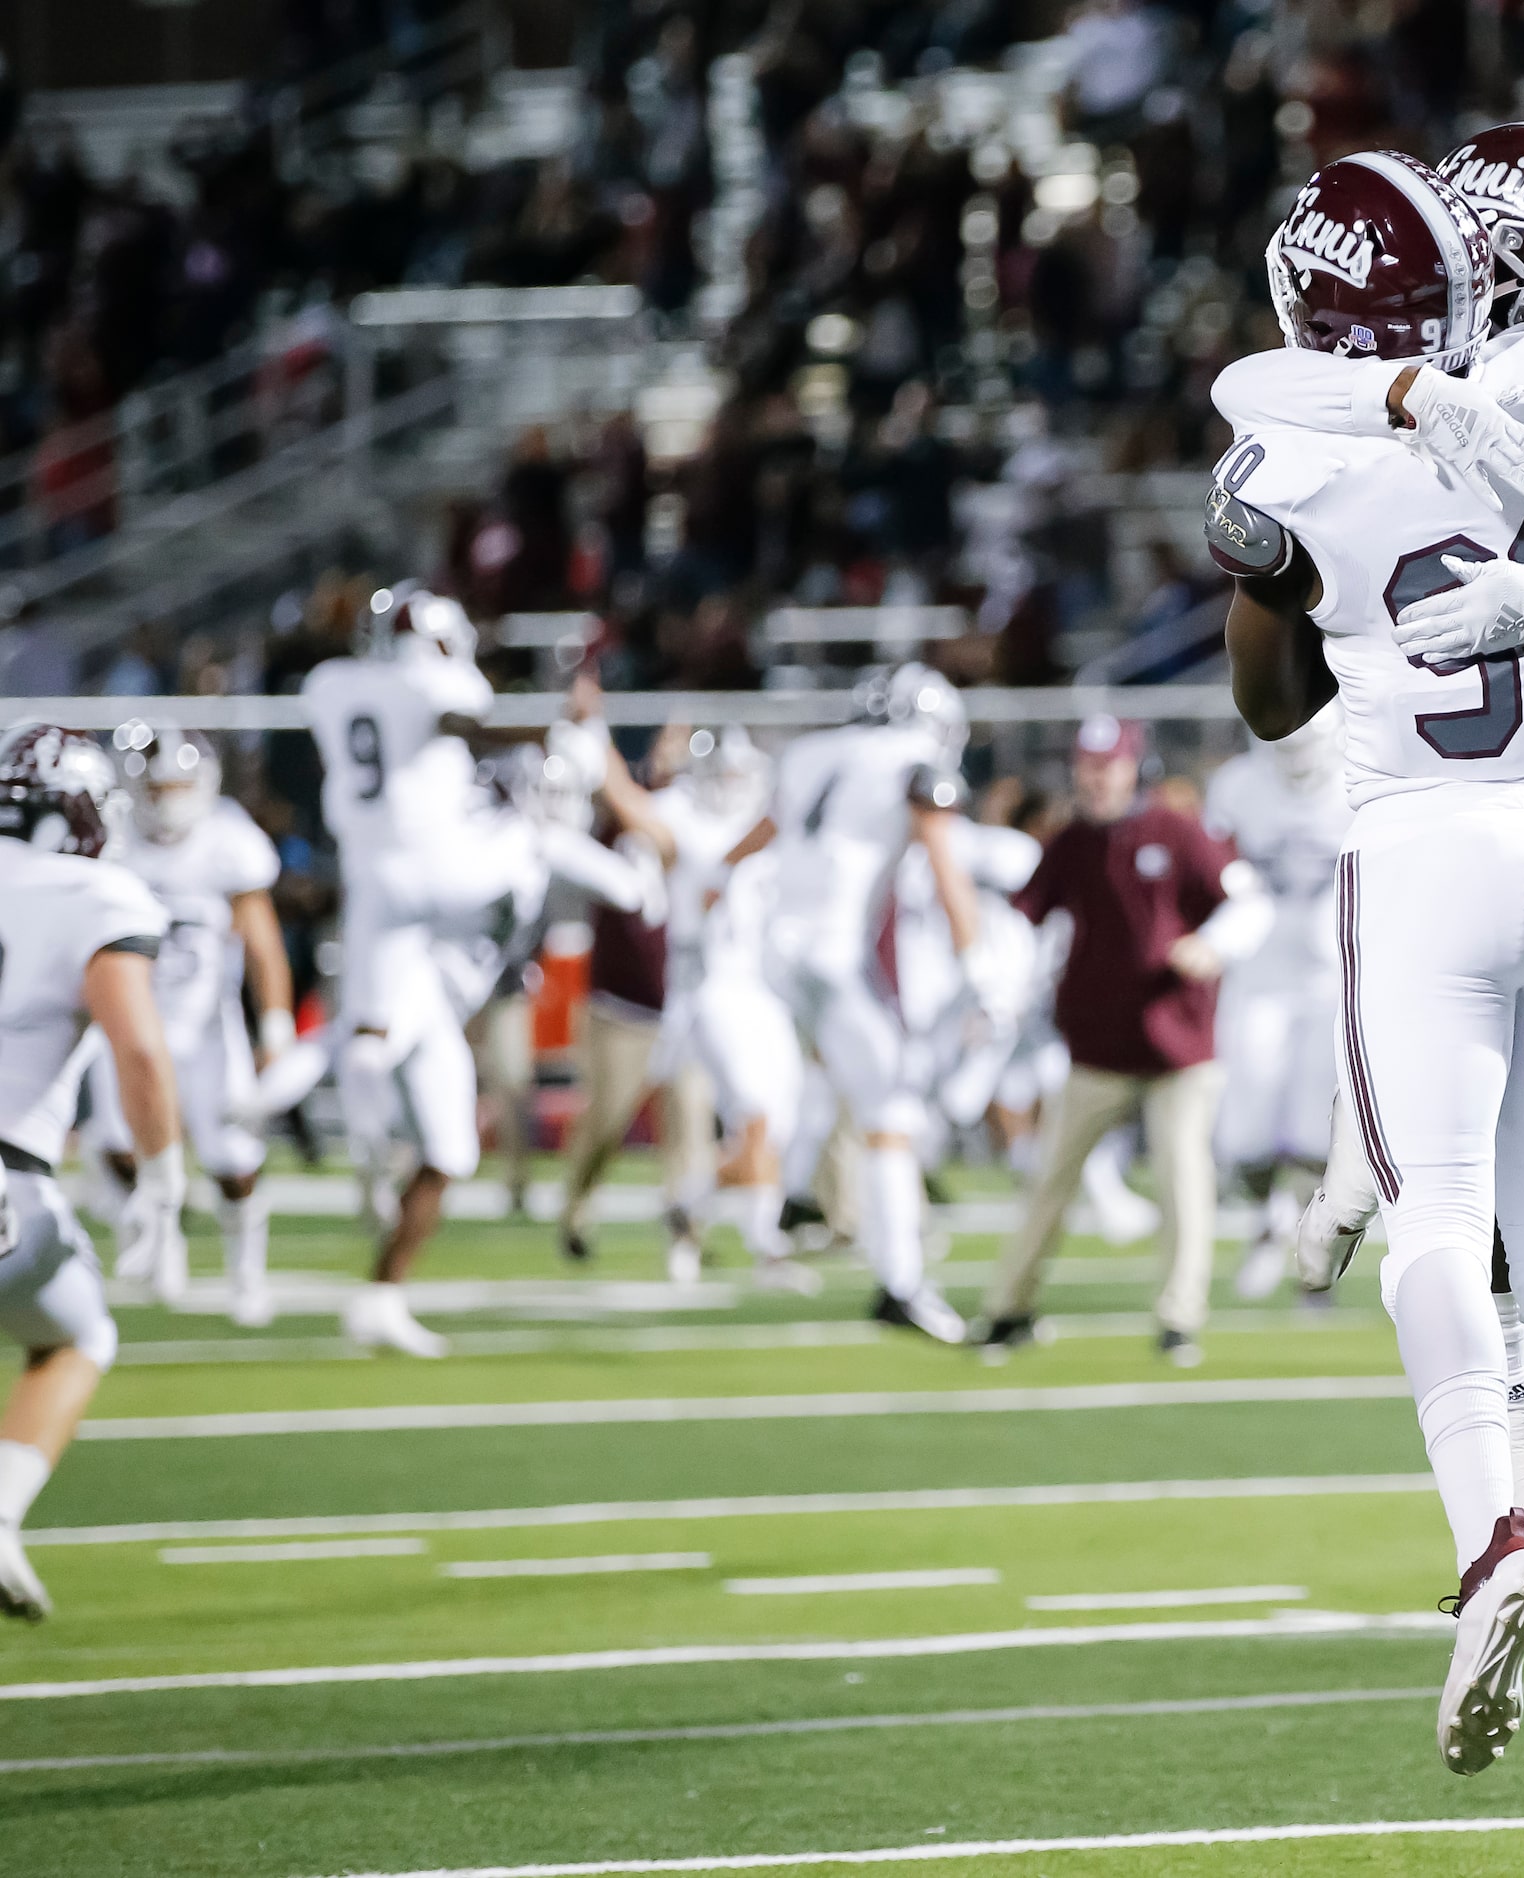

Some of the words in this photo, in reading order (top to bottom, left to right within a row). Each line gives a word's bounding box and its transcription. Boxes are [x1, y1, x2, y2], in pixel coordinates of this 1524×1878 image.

[1279, 186, 1375, 288] Ennis
[1436, 402, 1469, 448] adidas
[348, 713, 386, 801] 9
